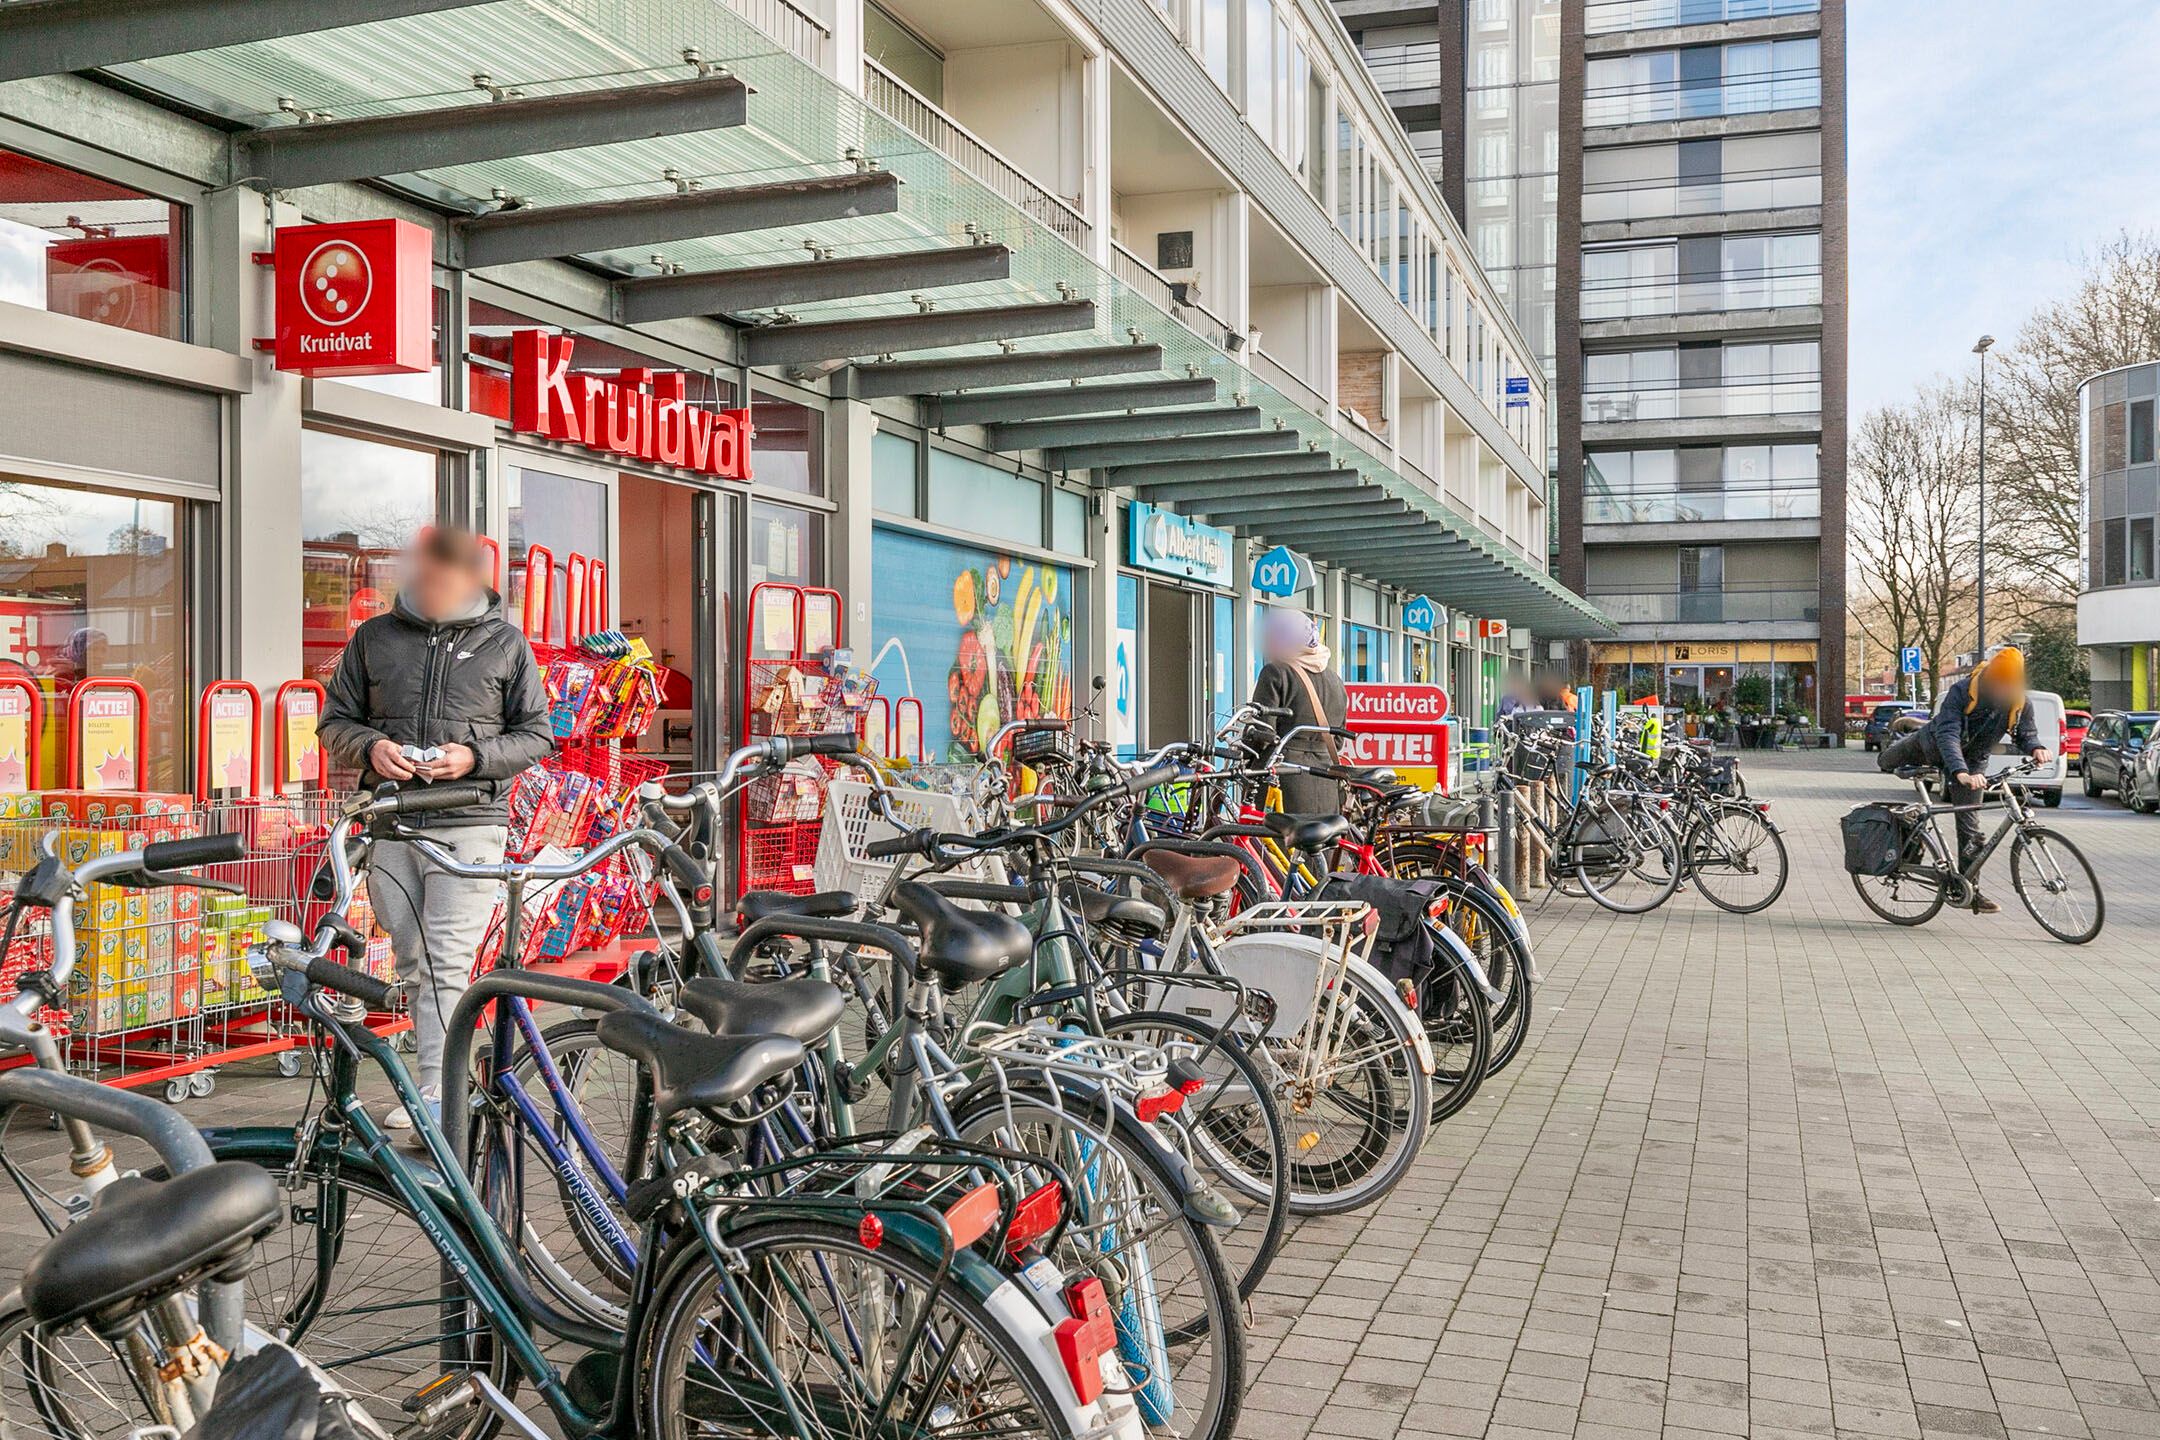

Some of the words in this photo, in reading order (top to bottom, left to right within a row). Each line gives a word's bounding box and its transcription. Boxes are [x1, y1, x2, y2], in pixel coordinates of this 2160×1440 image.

[300, 331, 373, 353] Kruidvat
[514, 330, 755, 481] Kruidvat
[1906, 650, 1917, 663] P
[88, 700, 128, 715] ACTIE!
[215, 702, 245, 717] ACTIE!
[290, 700, 314, 714] ACTIE!
[1351, 692, 1439, 714] Kruidvat
[1338, 733, 1433, 763] ACTIE!
[559, 1160, 623, 1245] UNION
[418, 1210, 463, 1272] SPARTA
